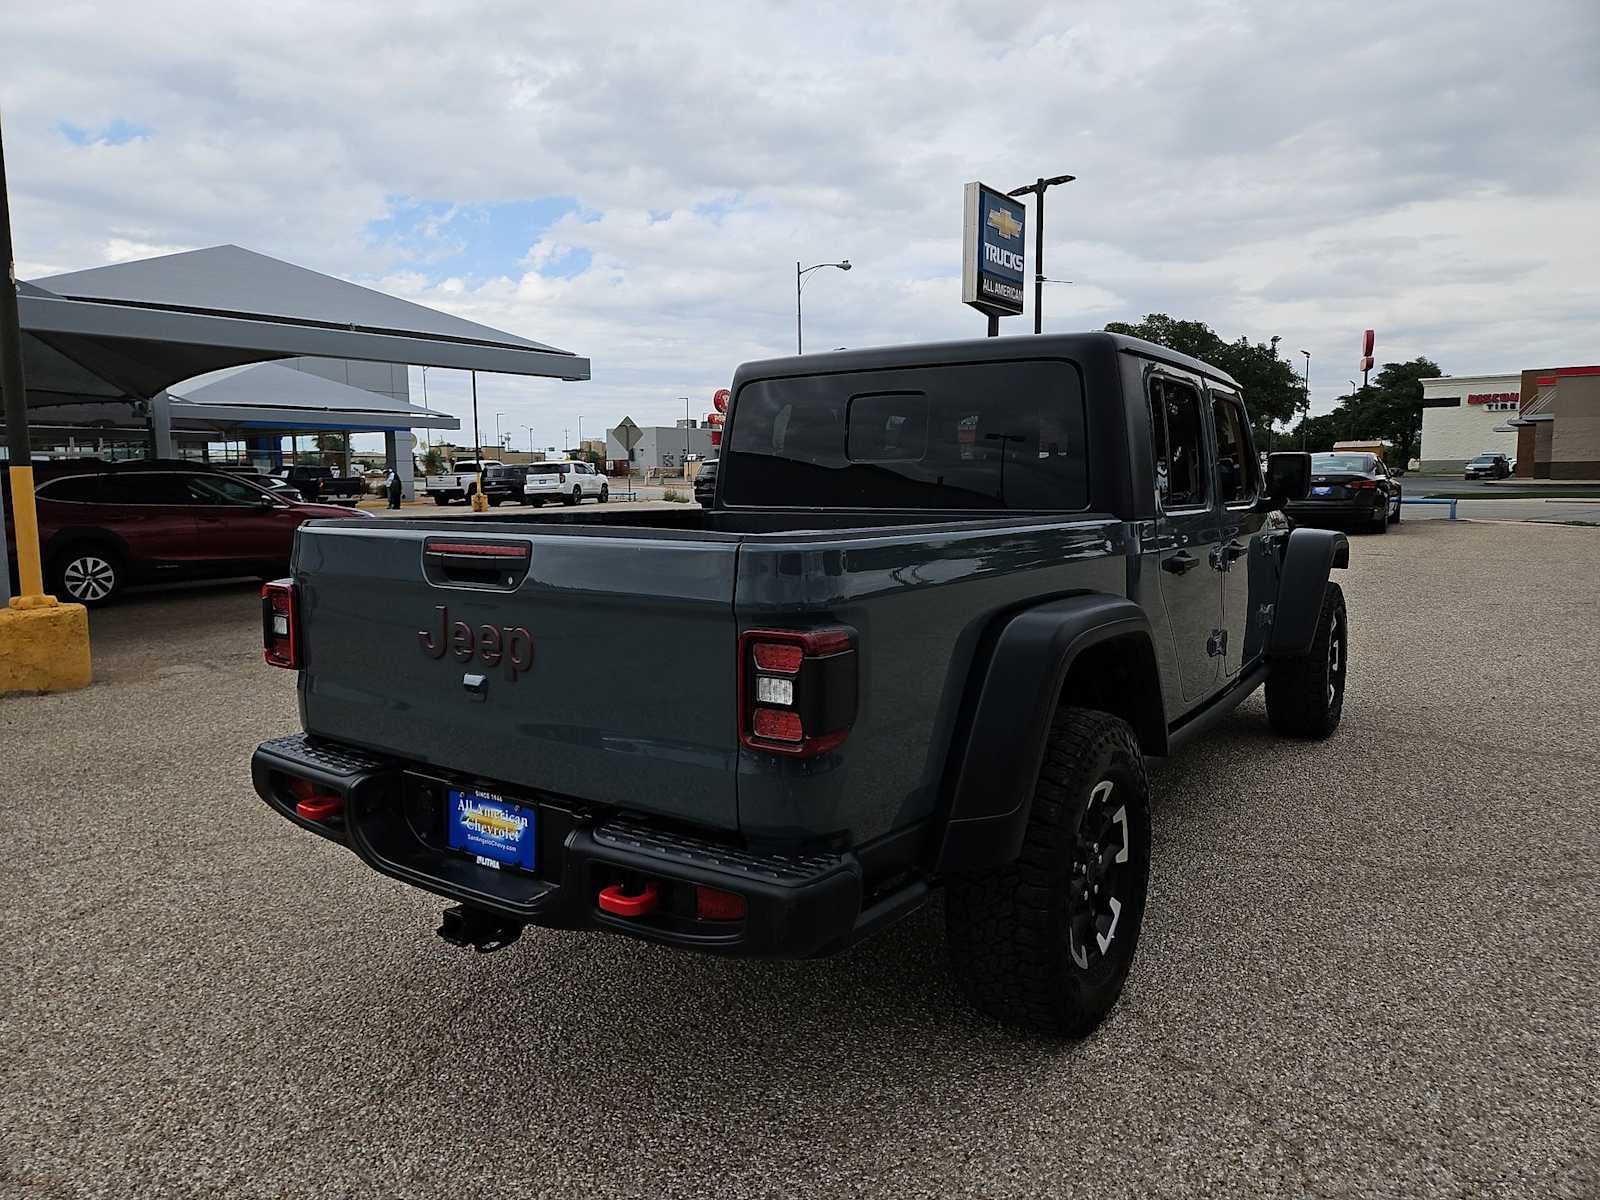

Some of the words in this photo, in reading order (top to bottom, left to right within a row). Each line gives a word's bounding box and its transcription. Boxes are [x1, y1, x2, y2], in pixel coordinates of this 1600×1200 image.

[984, 241, 1023, 272] TRUCKS
[983, 278, 994, 293] ALL
[994, 282, 1023, 301] AMERICAN
[417, 604, 534, 682] Jeep
[475, 790, 490, 800] SINCE
[458, 799, 473, 812] All
[478, 803, 528, 827] American
[466, 817, 520, 842] Chevrolet
